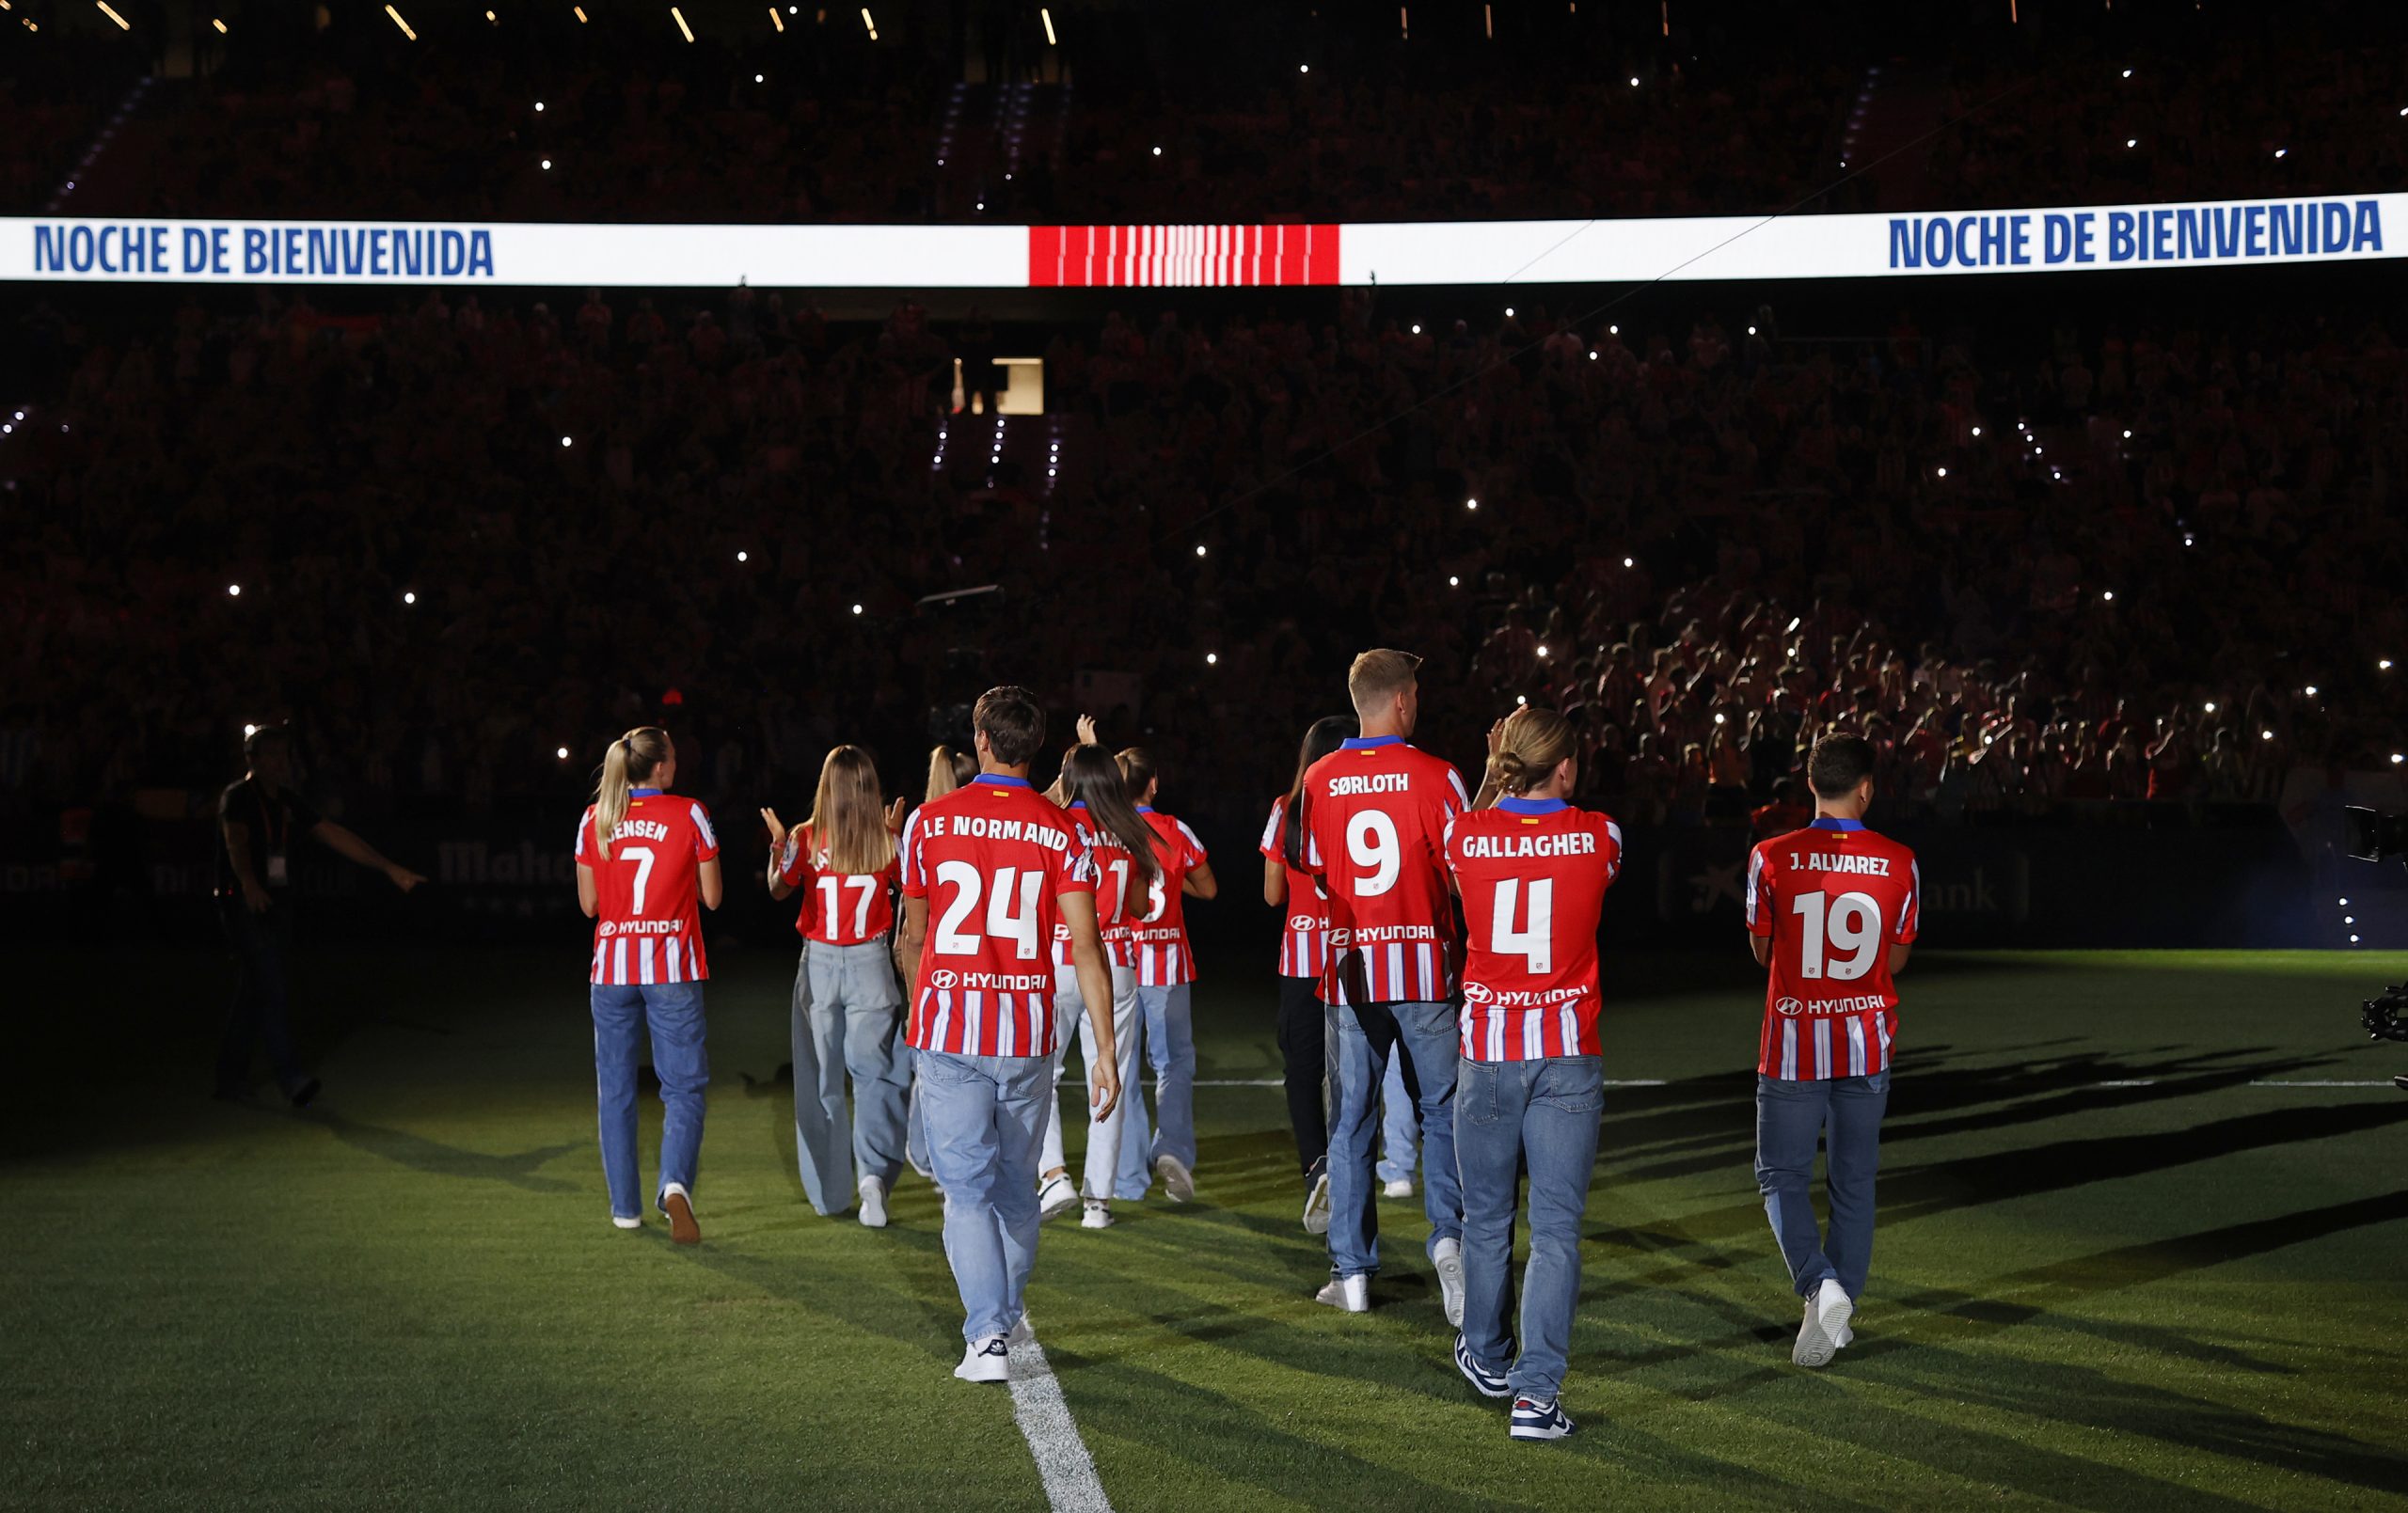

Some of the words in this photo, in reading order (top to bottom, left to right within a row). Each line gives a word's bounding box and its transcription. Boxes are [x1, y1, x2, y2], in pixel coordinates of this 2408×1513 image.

[34, 225, 168, 273] NOCHE
[182, 227, 230, 274] DE
[244, 228, 495, 277] BIENVENIDA
[1890, 215, 2031, 268] NOCHE
[2044, 213, 2096, 263] DE
[2108, 200, 2383, 262] BIENVENIDA
[1328, 773, 1409, 797] SØRLOTH
[924, 816, 945, 839] LE
[953, 815, 1069, 852] NORMAND
[1463, 832, 1596, 859] GALLAGHER
[1346, 809, 1401, 897] 9
[1790, 852, 1804, 871] J.
[1809, 852, 1890, 877] ALVAREZ
[619, 846, 656, 916] 7
[816, 875, 878, 940] 17
[934, 860, 1045, 960] 24
[1491, 877, 1553, 975] 4
[619, 920, 683, 934] HYUNDAI
[1355, 925, 1435, 942] HYUNDAI
[1793, 890, 1882, 981] 19
[962, 971, 1047, 990] HYUNDAI
[1497, 984, 1589, 1006] HYUNDAI
[1808, 995, 1886, 1015] HYUNDAI
